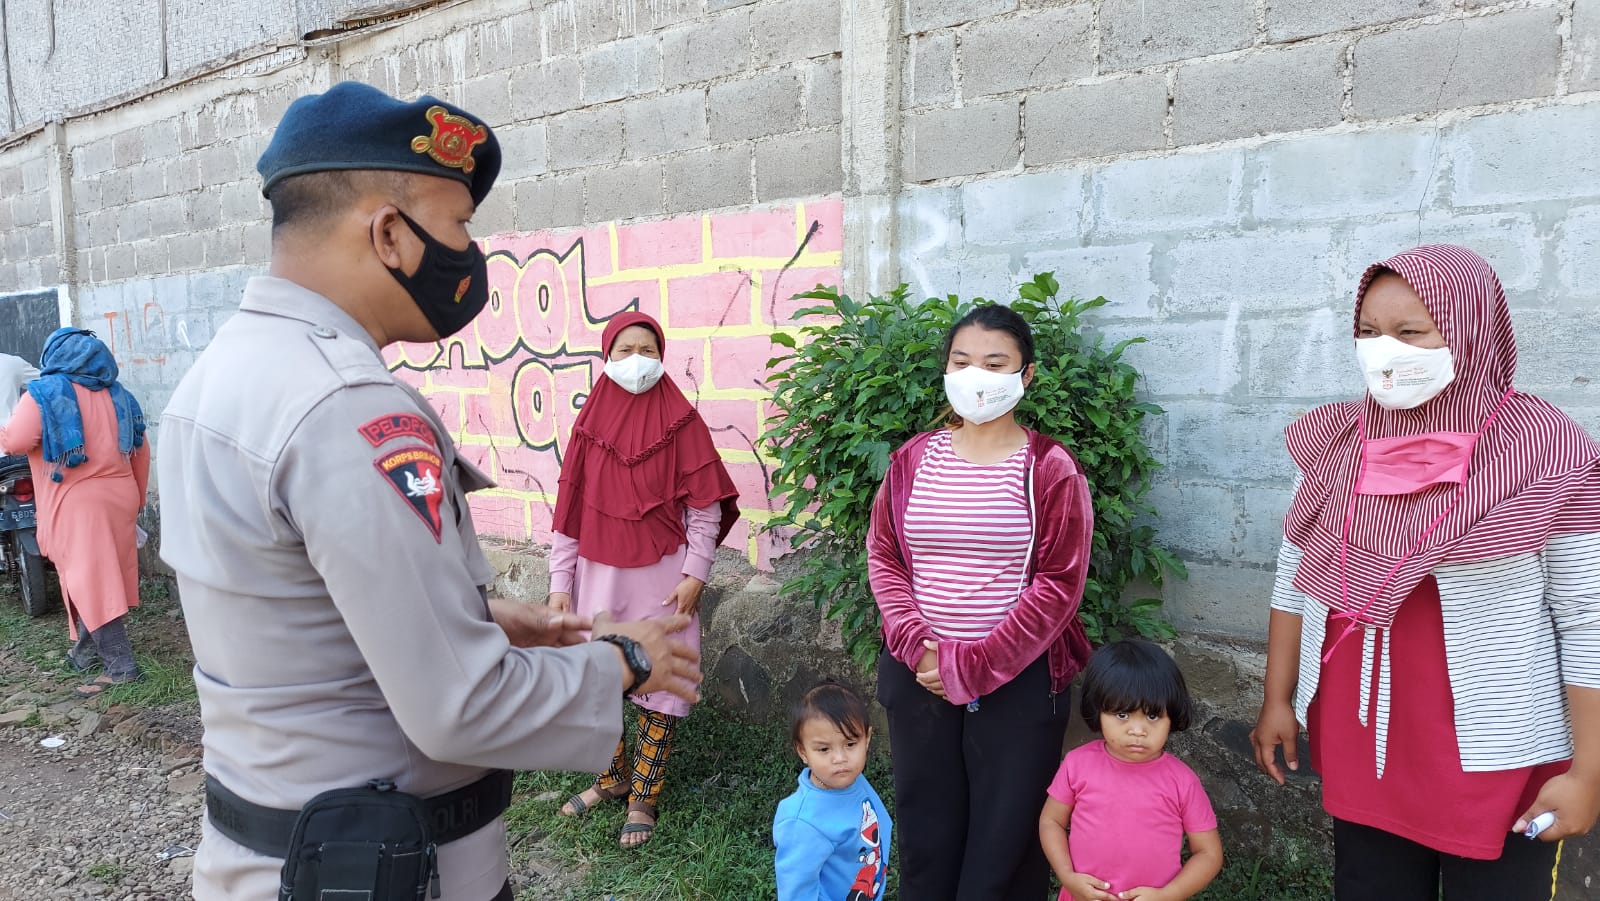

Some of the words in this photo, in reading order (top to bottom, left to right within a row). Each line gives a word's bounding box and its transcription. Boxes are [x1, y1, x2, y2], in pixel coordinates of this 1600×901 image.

[366, 416, 430, 440] PELOPO
[382, 452, 413, 471] KORPS
[433, 791, 479, 834] OLRI
